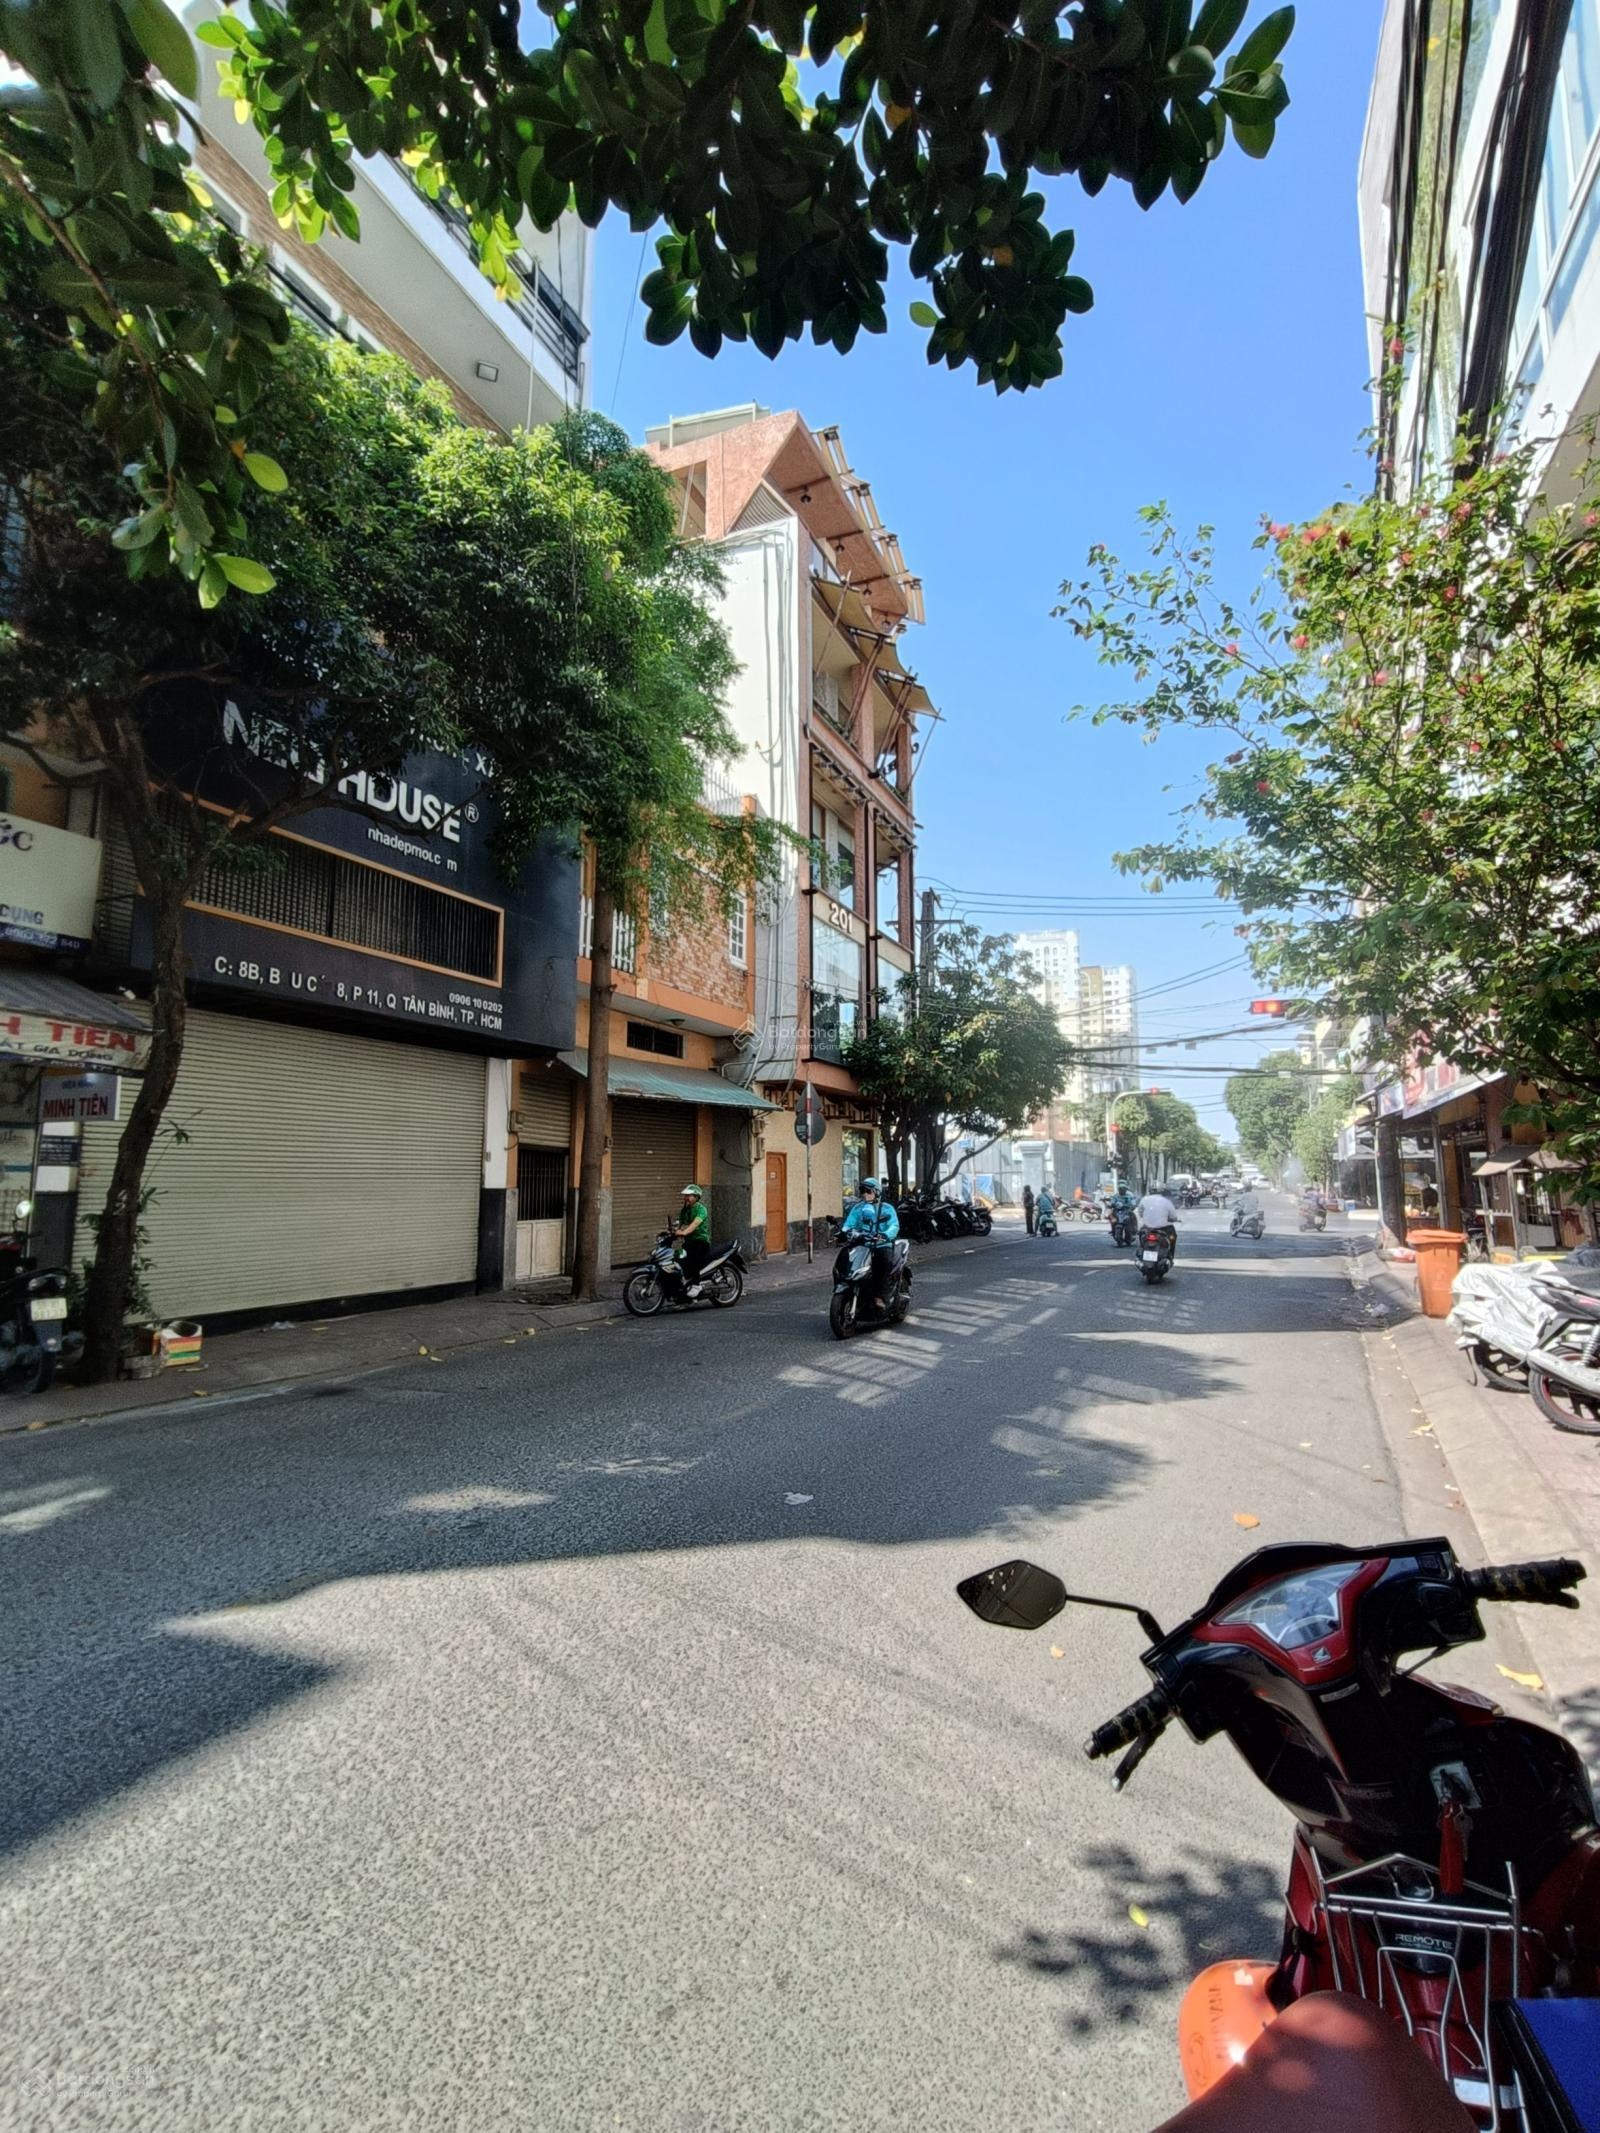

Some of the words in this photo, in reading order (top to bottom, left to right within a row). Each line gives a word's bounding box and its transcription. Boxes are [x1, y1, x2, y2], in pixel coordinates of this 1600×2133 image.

[829, 902, 853, 934] 201
[402, 994, 426, 1015] TÂN
[428, 1000, 458, 1023] BÌNH,
[460, 1008, 478, 1026] TP.
[480, 1013, 503, 1031] HCM
[448, 992, 471, 1007] 0906
[43, 1098, 75, 1119] MINH
[80, 1093, 109, 1116] TIÊN
[1394, 1933, 1454, 1950] REMOTE
